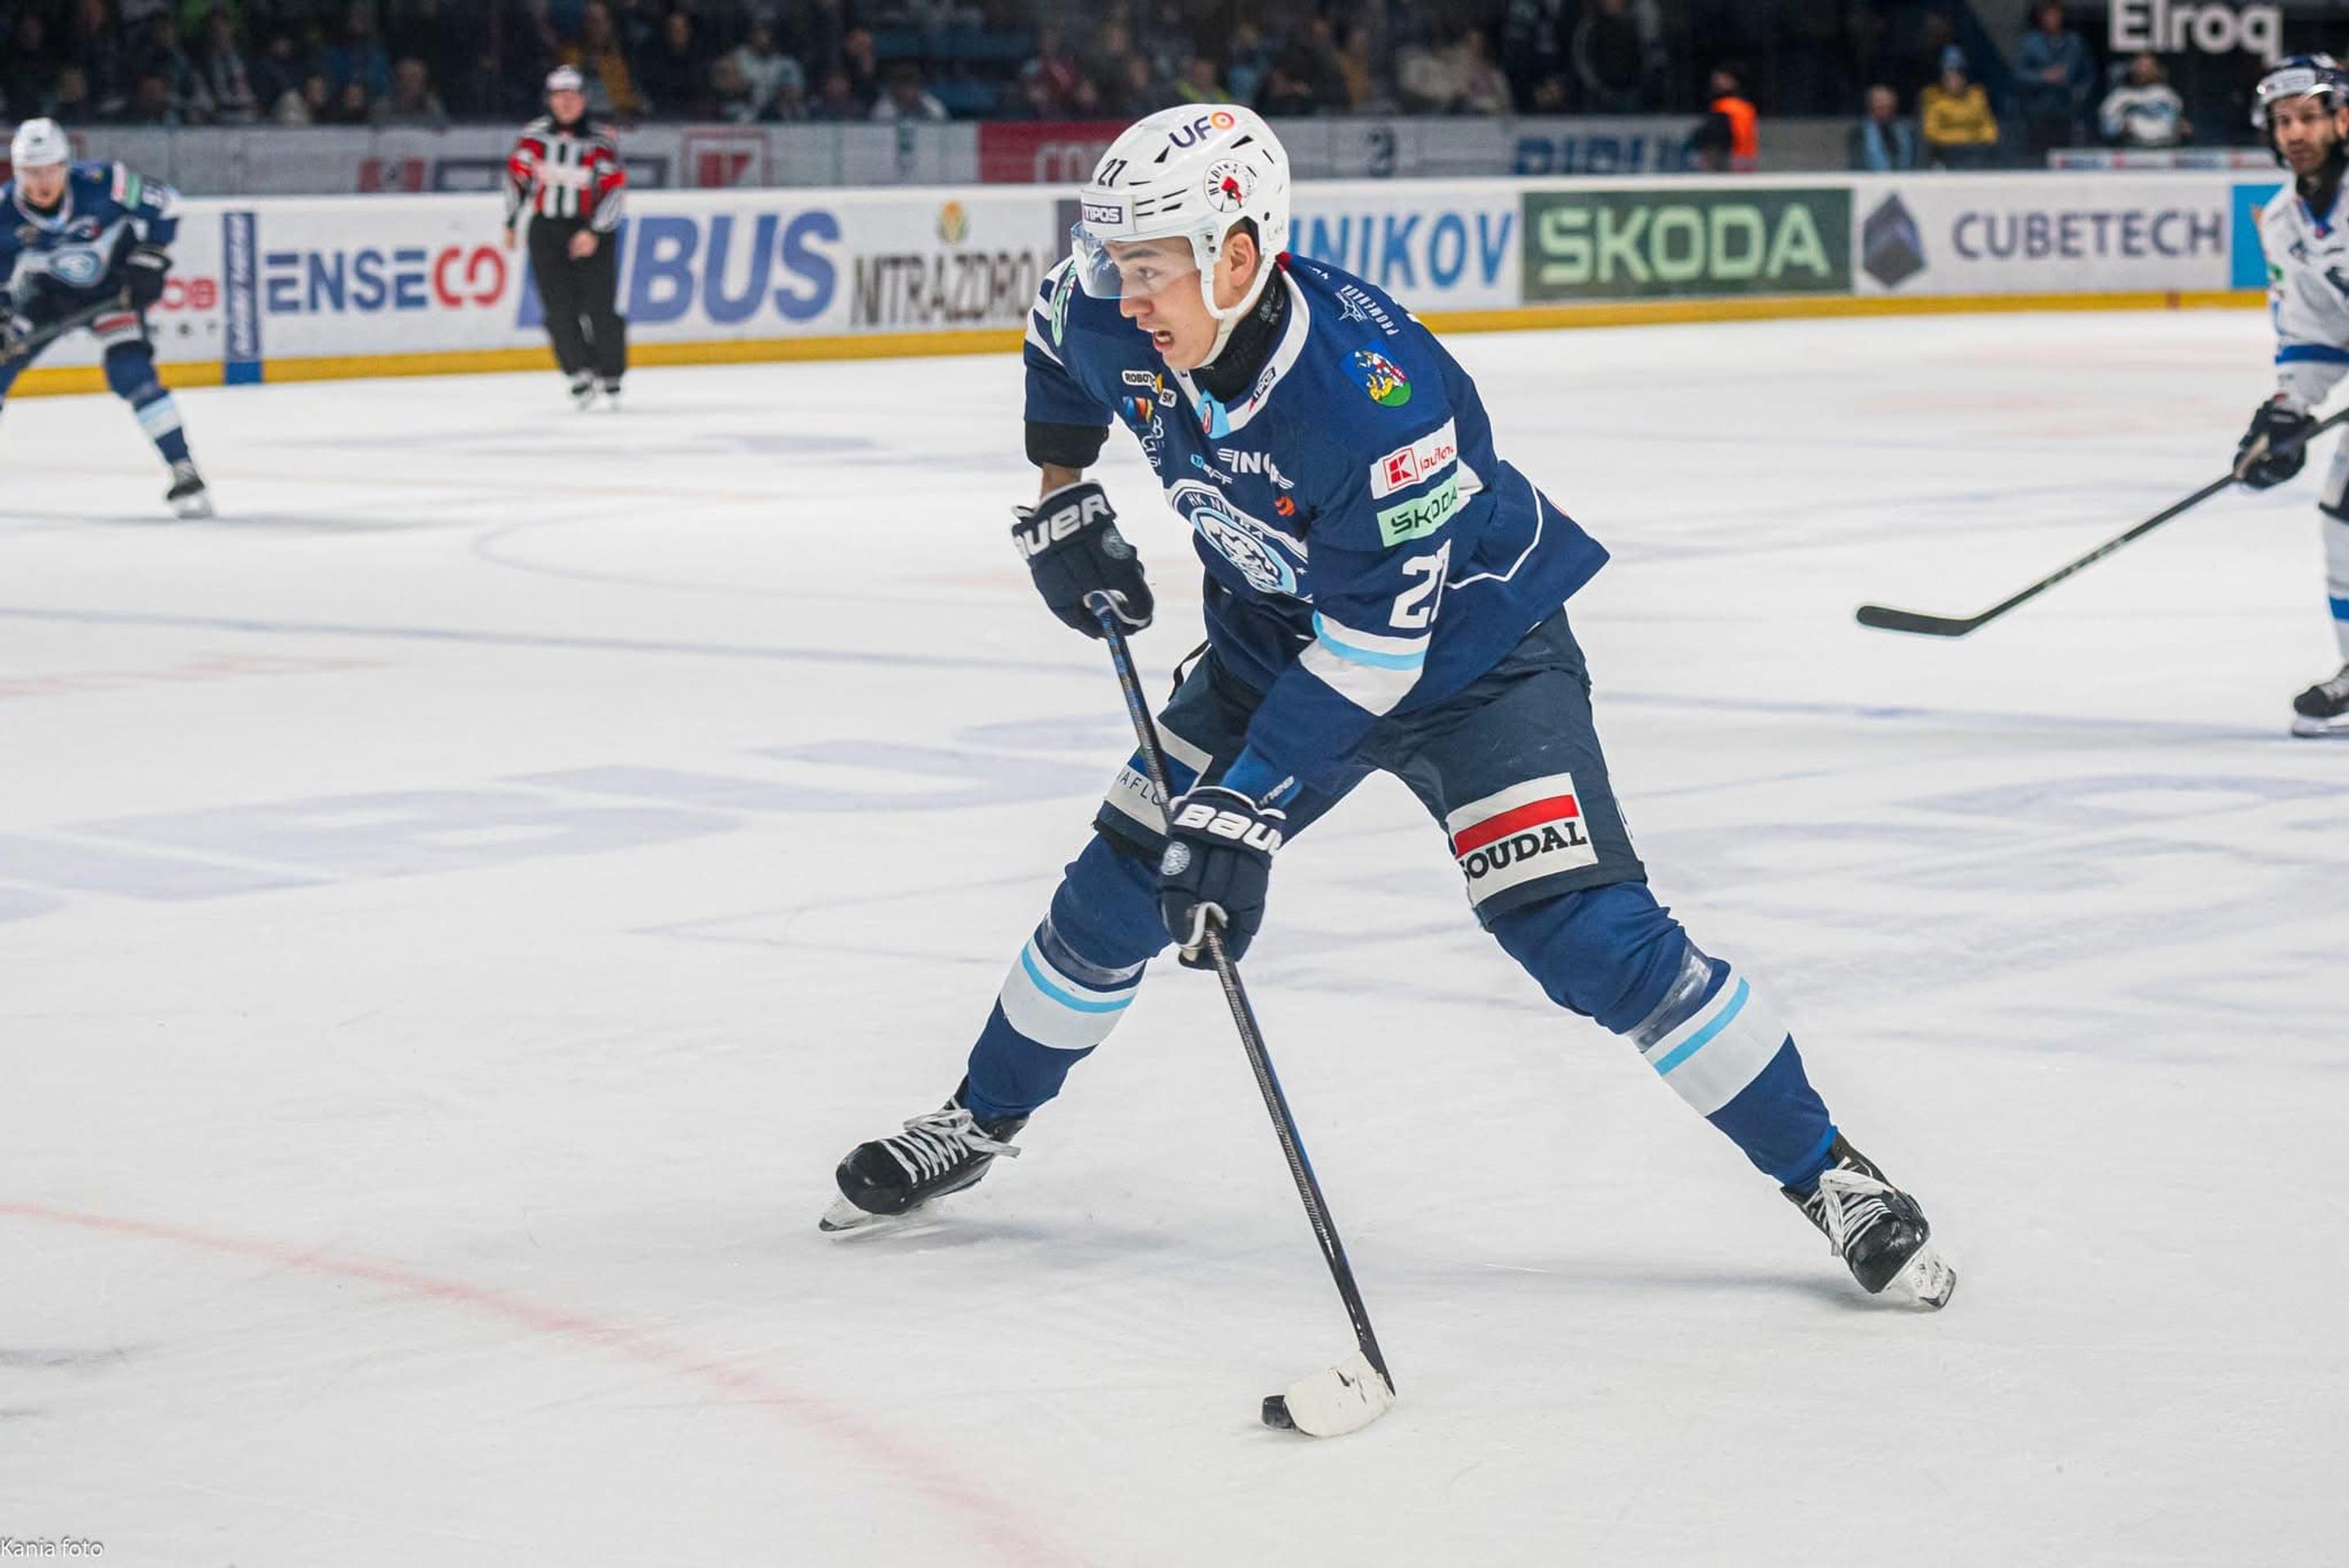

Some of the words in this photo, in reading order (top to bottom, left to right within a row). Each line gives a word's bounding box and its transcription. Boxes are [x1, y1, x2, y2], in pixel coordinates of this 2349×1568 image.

[2109, 0, 2282, 67] Elroq
[1169, 111, 1235, 148] UFO
[1097, 158, 1129, 188] 27
[1084, 205, 1121, 222] TIPOS
[1952, 211, 2223, 261] CUBETECH
[265, 247, 508, 313] ENSECO
